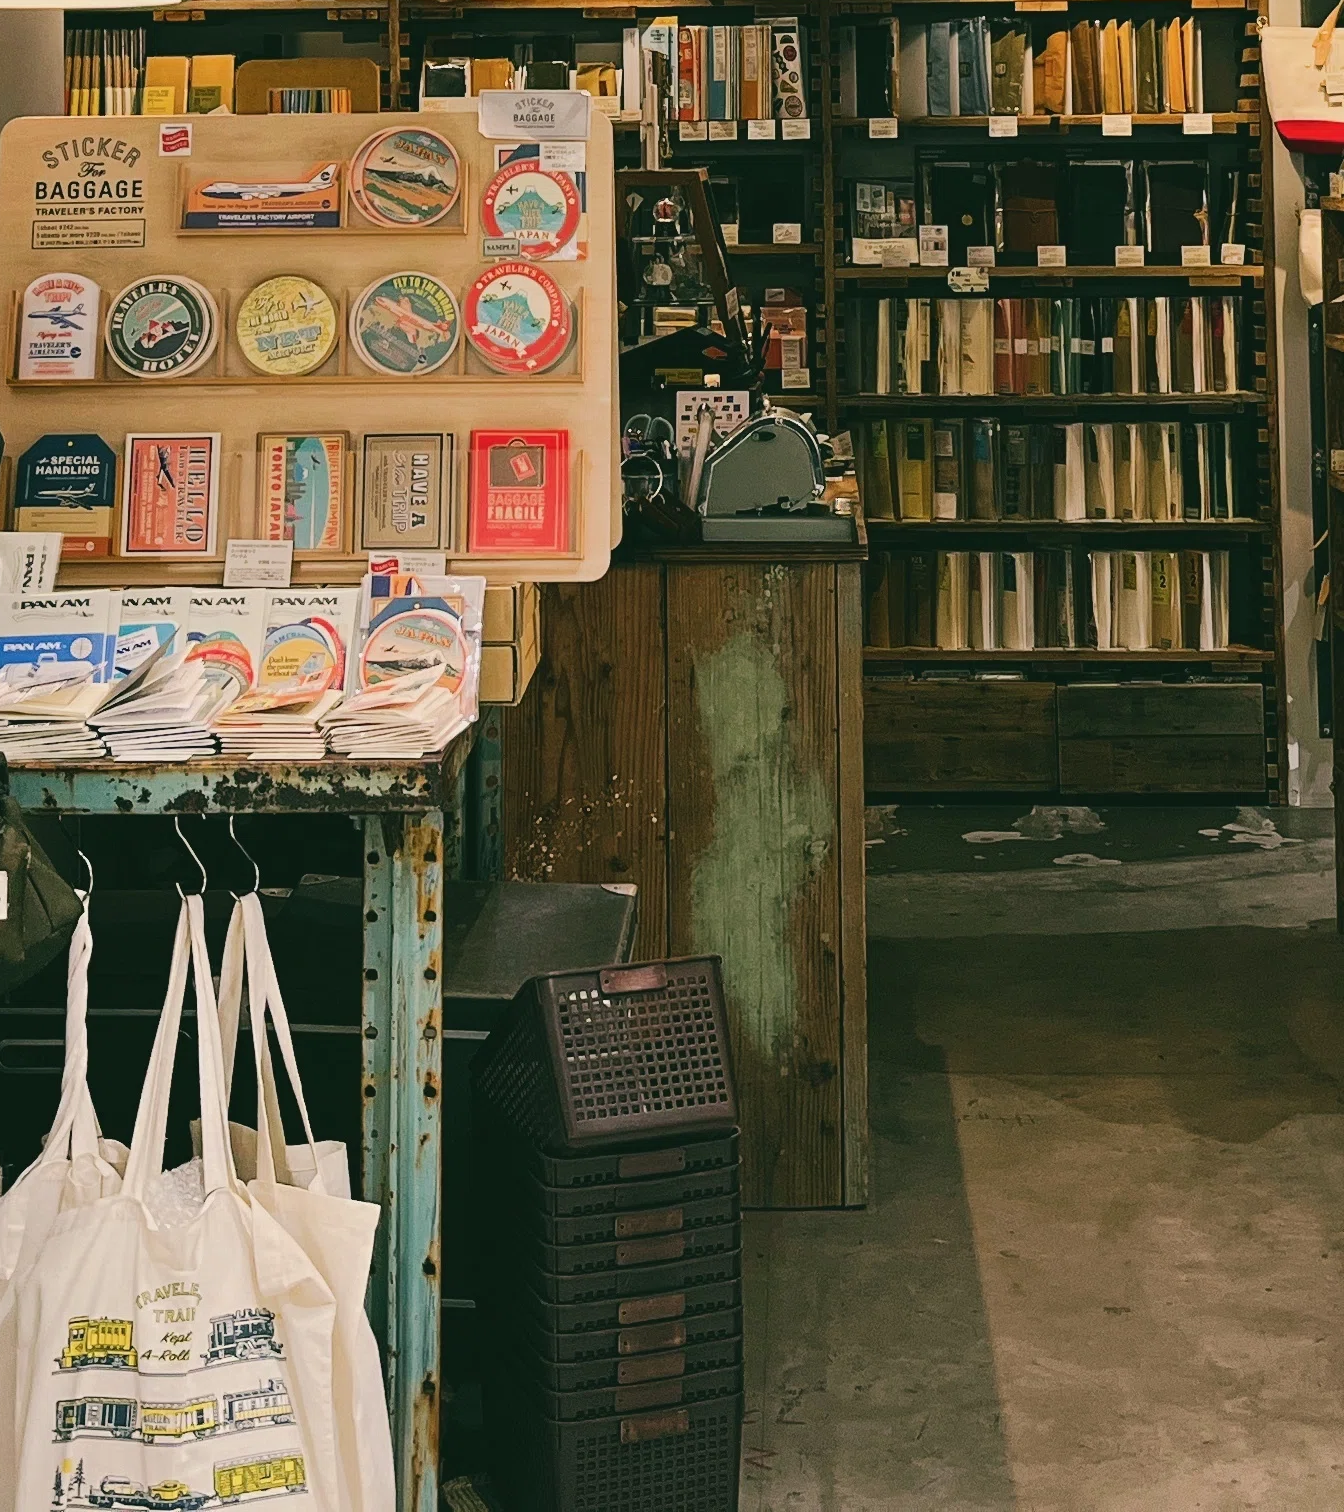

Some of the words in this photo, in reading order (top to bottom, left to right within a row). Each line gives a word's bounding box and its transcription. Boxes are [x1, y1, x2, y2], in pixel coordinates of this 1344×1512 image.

[515, 97, 555, 110] STICKER
[513, 114, 555, 123] BAGGAGE
[41, 137, 141, 169] STICKER
[394, 138, 449, 166] JAPAN
[77, 161, 107, 178] For
[488, 163, 535, 197] TRAVELER'S
[35, 180, 143, 200] BAGGAGE
[36, 207, 95, 216] TRAVELER'S
[513, 231, 550, 239] JAPAN
[393, 276, 408, 290] FLY
[409, 276, 420, 287] TO
[422, 278, 439, 296] THE
[435, 291, 455, 321] WORLD
[481, 264, 537, 284] TRAVELER'S
[538, 276, 561, 319] COMPANY
[112, 281, 180, 330] TRAVELER'S
[256, 325, 322, 352] NRT
[484, 325, 520, 348] JAPAN
[143, 331, 201, 372] HOTEL
[266, 344, 317, 362] AIRPORT
[35, 465, 100, 475] HANDLING
[50, 456, 100, 465] SPECIAL
[270, 446, 283, 492] TOKYO
[411, 454, 430, 506] HAVE
[185, 446, 206, 542] HELLO
[488, 493, 545, 505] BAGGAGE
[269, 497, 282, 541] JAPAN
[391, 489, 408, 534] TRIP
[411, 513, 425, 528] A
[487, 506, 545, 520] FRAGILE
[20, 599, 58, 610] PAN
[60, 598, 92, 608] AM
[143, 597, 172, 606] AM
[215, 597, 246, 605] AM
[271, 597, 306, 606] PAN
[310, 597, 338, 605] AM
[394, 624, 452, 648] JAPAN
[3, 642, 35, 652] PAN
[36, 642, 62, 651] AM
